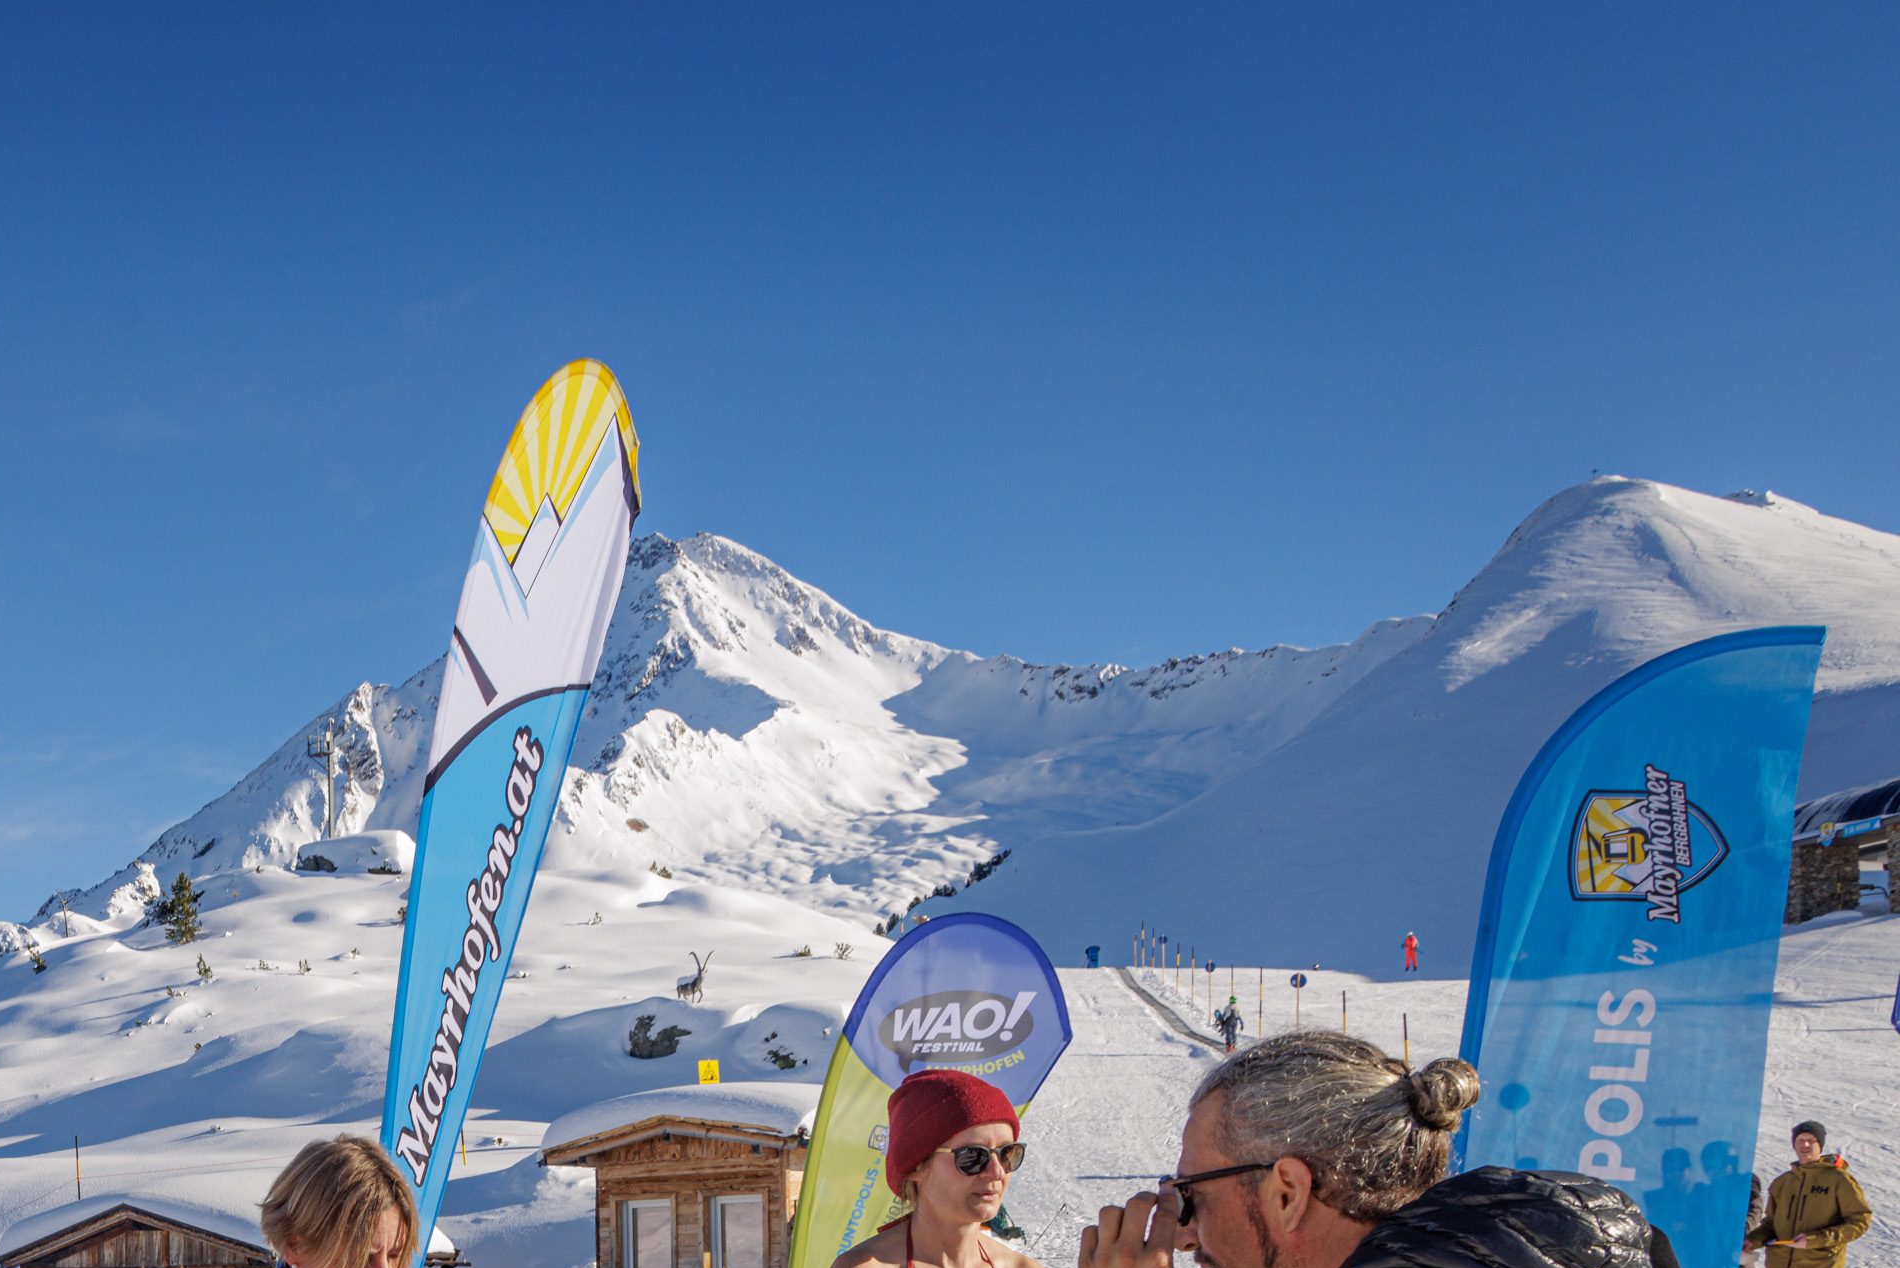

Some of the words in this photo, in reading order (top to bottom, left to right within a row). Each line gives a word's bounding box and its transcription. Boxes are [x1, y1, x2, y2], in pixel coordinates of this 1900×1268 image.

[1640, 765, 1682, 922] Mayrhofner
[1671, 782, 1690, 865] BERGBAHNEN
[397, 726, 543, 1186] Mayrhofen.at
[893, 991, 1037, 1042] WAO!
[1578, 989, 1656, 1181] POLIS
[1618, 939, 1657, 965] by
